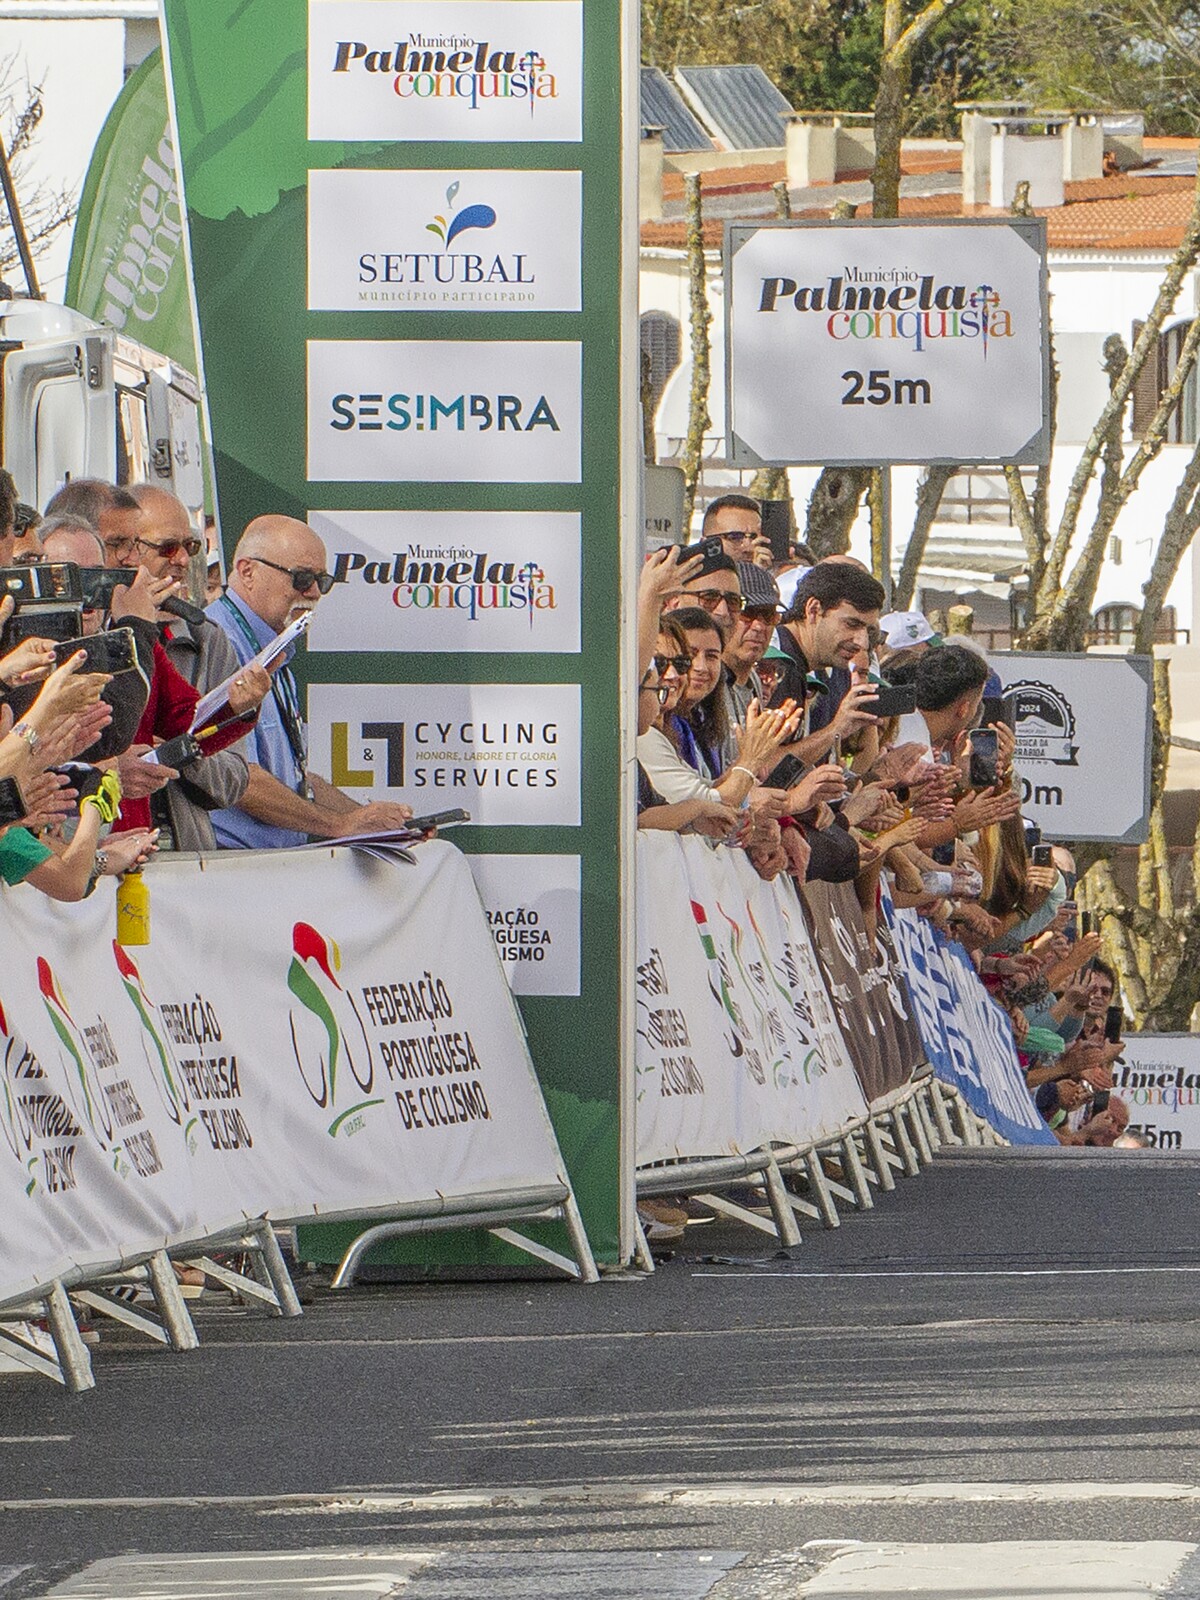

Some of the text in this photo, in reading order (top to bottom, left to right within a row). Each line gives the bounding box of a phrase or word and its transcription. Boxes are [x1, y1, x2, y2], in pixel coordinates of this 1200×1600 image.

[332, 41, 518, 73] Palmela
[409, 33, 475, 50] Município
[394, 72, 559, 112] conquista
[844, 266, 918, 286] Município
[757, 275, 968, 313] Palmela
[827, 309, 1016, 356] conquista
[841, 369, 931, 405] 25m
[334, 553, 517, 584] Palmela
[407, 544, 474, 562] Município
[392, 583, 558, 623] conquista
[1019, 704, 1041, 713] 2024
[415, 722, 558, 744] CYCLING
[415, 751, 557, 763] HONORE, LABORE ET GLORIA
[415, 768, 558, 788] SERVICES
[500, 946, 545, 962] ISMO
[362, 970, 453, 1032] FEDERAÇÃO
[379, 1031, 481, 1081] PORTUGUESA
[395, 1089, 423, 1131] DE
[418, 1080, 491, 1128] CICLISMO
